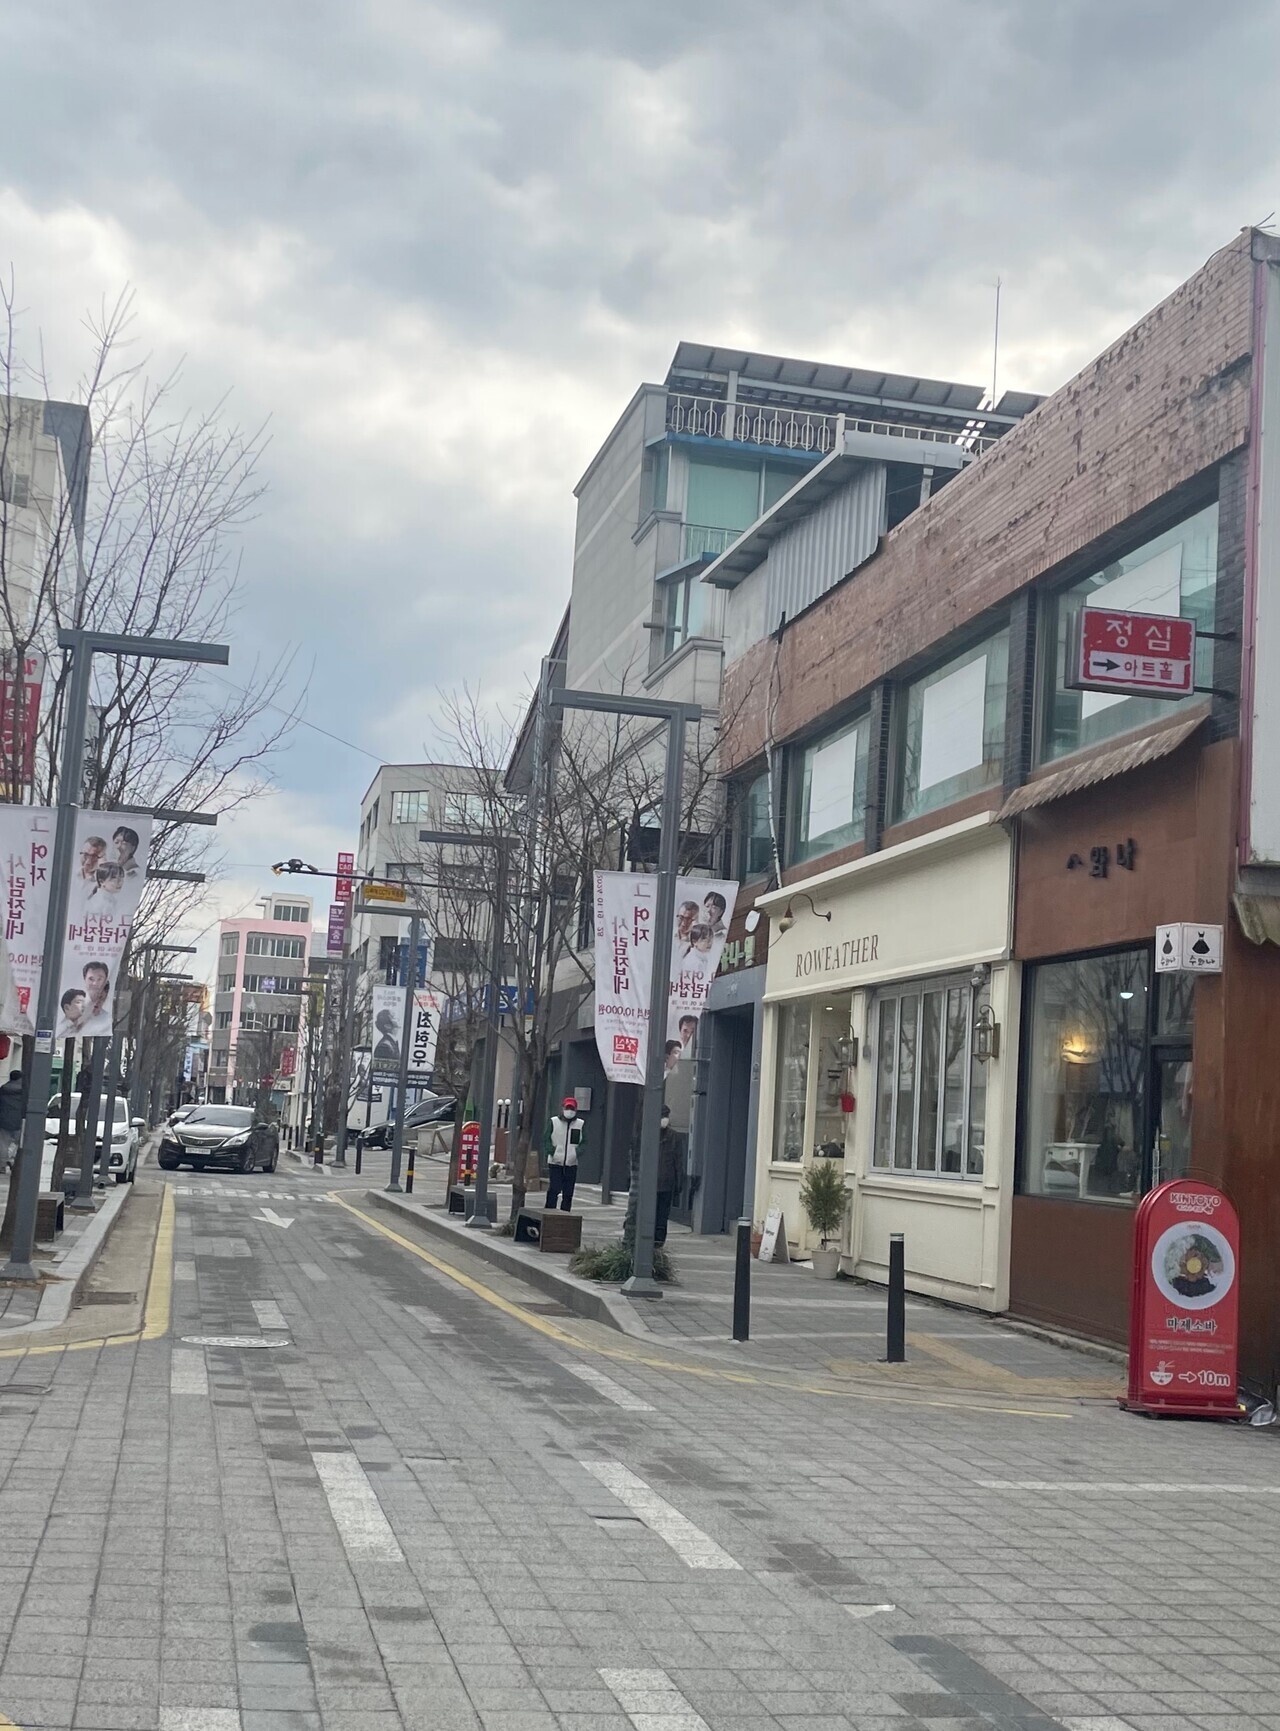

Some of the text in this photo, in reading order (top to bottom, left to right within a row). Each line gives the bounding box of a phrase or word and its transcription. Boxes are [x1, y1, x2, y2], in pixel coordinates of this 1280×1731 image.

[1124, 659, 1173, 680] 아트홀
[795, 934, 878, 977] ROWEATHER
[1166, 1316, 1217, 1336] 마제소바
[1198, 1370, 1230, 1387] 10m
